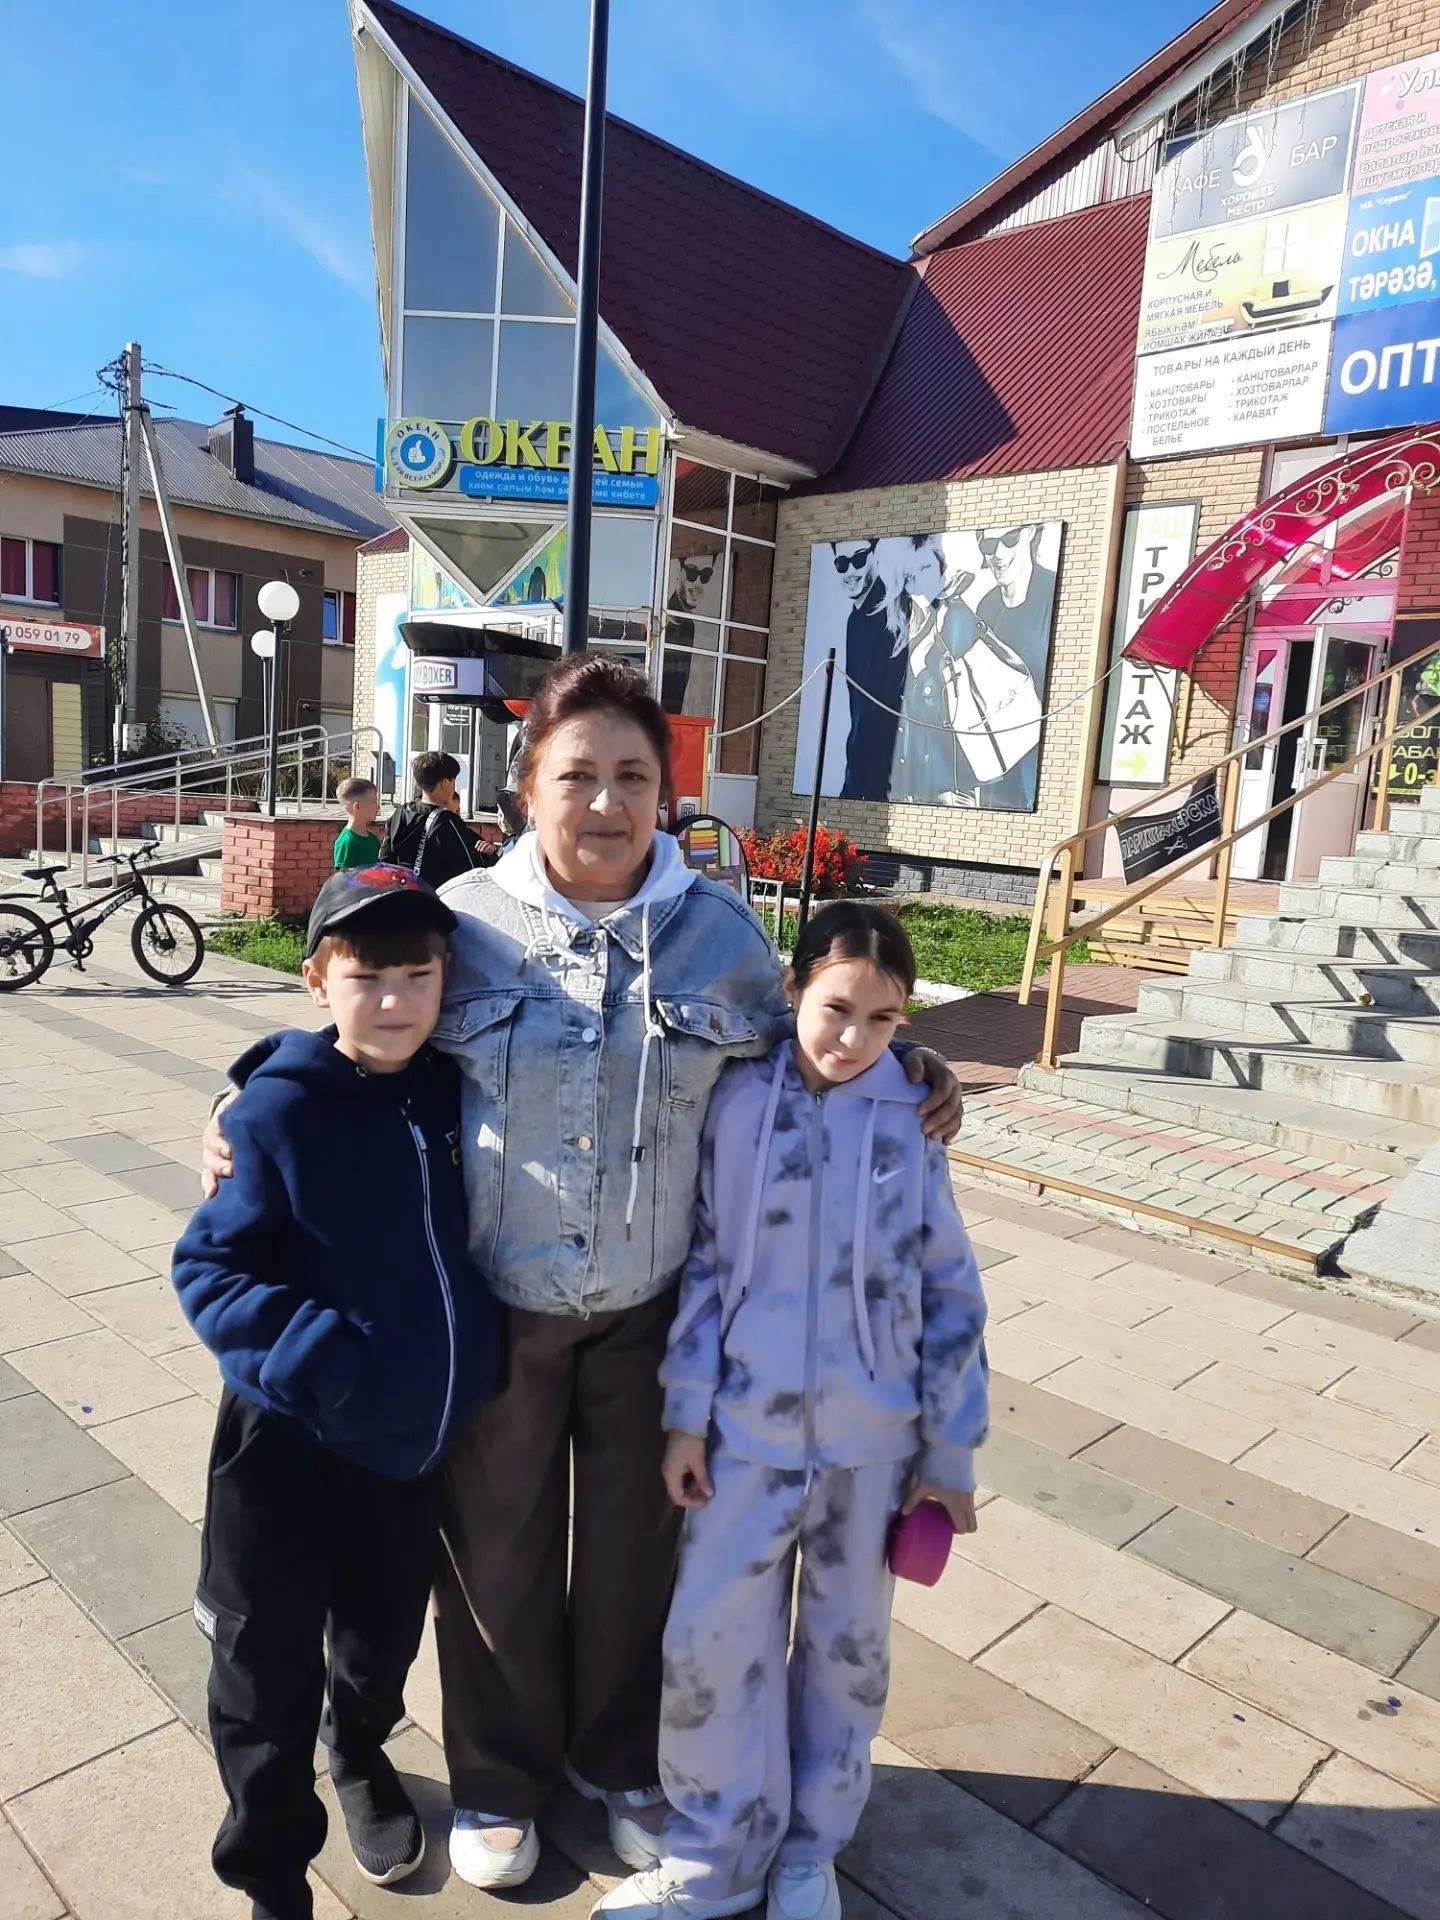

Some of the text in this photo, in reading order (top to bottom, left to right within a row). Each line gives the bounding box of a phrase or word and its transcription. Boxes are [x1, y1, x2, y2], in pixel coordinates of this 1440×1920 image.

[1364, 112, 1427, 141] детская и
[1171, 135, 1338, 198] КАФЕ БАР
[1219, 184, 1276, 207] ХОРОШЕЕ
[1226, 199, 1266, 218] МЕСТО
[1351, 218, 1415, 257] ОКНА
[1157, 240, 1243, 282] Мебель
[1147, 288, 1212, 309] КОРПУСНАЯ И
[1146, 300, 1223, 322] МЯГКАЯ МЕБЕЛЬ
[1153, 339, 1311, 376] ТОВАРЫ НА КАЖДЫЙ ДЕНЬ
[1340, 338, 1440, 395] ОПТ
[1237, 361, 1318, 384] КАНЦТОВАРЛАР
[1150, 379, 1215, 398] КАНЦТОВАРЫ
[1235, 376, 1309, 397] ХОЗТОВАРЛАР
[1149, 393, 1206, 410] ХОЗТОВАРЫ
[1235, 393, 1289, 409] ТРИКОТАЖ
[1148, 407, 1198, 422] ТРИКОТАЖ
[1233, 407, 1278, 422] КАРАВАТ
[396, 422, 440, 440] ОКЕАН
[1147, 417, 1210, 435] ПОСТЕЛЬНОЕ
[1152, 433, 1184, 446] БЕЛЬЕ
[475, 469, 516, 482] одежда
[517, 472, 526, 481] и
[527, 472, 559, 485] обувь
[610, 479, 644, 489] семьи
[16, 626, 40, 640] 059
[44, 629, 60, 642] 01
[65, 631, 80, 644] 79
